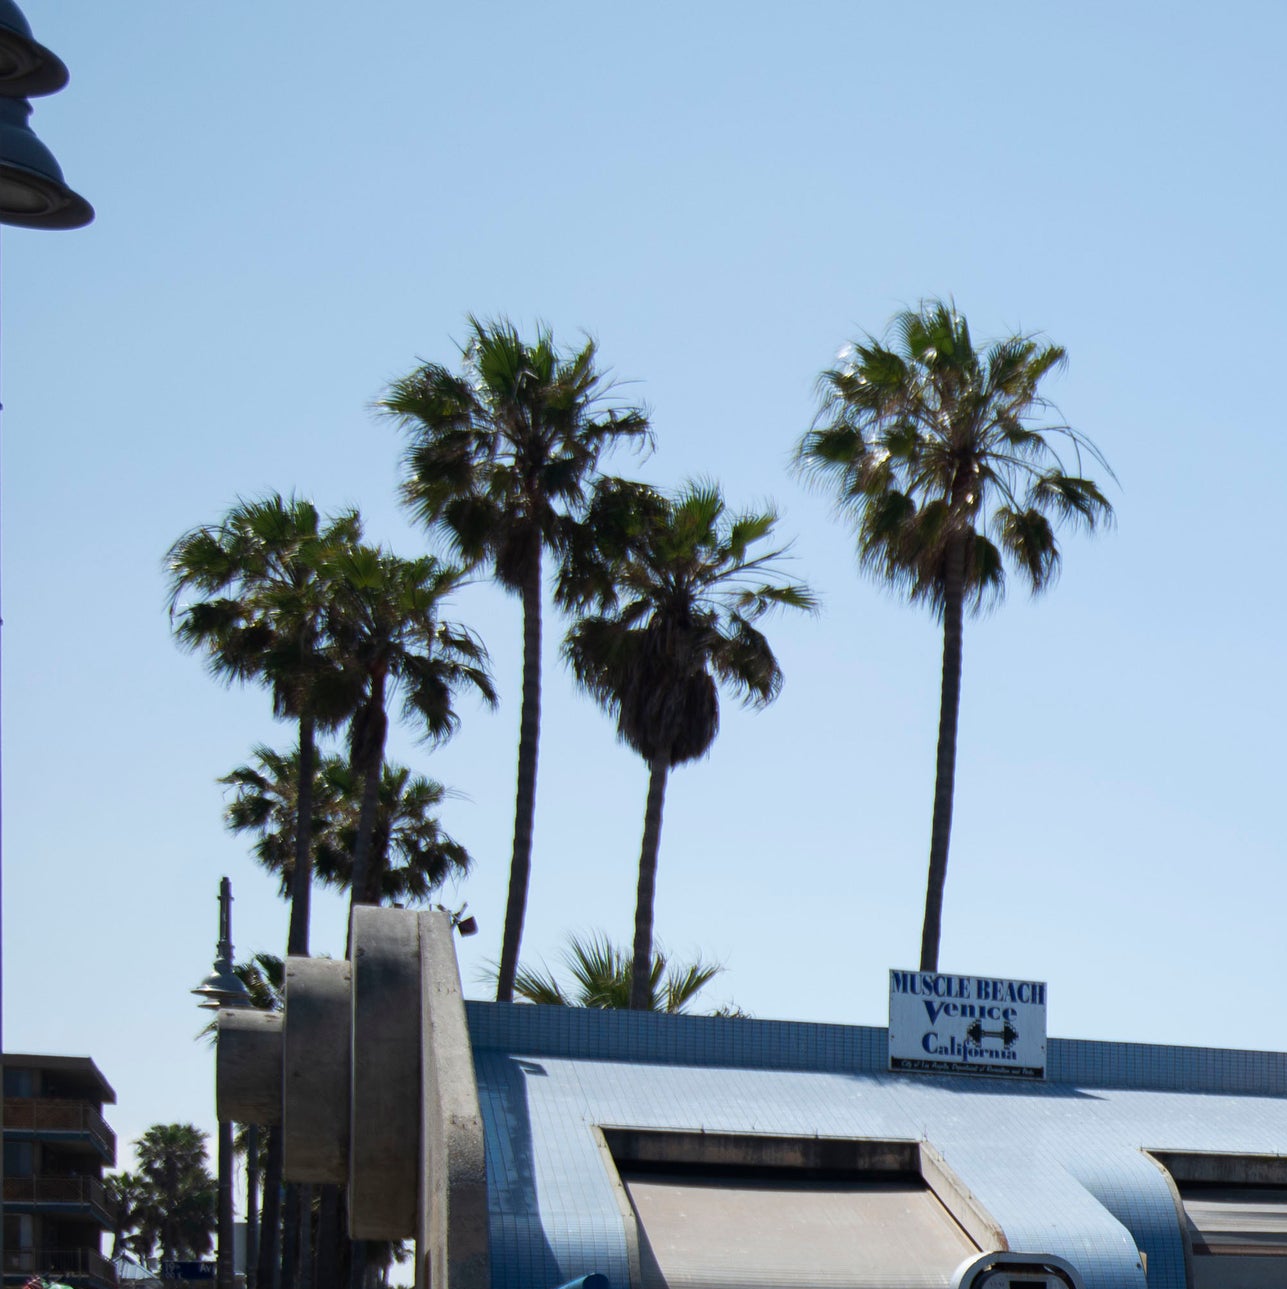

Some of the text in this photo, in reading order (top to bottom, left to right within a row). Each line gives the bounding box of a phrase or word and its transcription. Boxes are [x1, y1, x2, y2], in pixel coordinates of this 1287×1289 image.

[892, 972, 1045, 1005] MUSCLE BEACH
[923, 1000, 1017, 1026] Venice
[922, 1032, 1017, 1061] California
